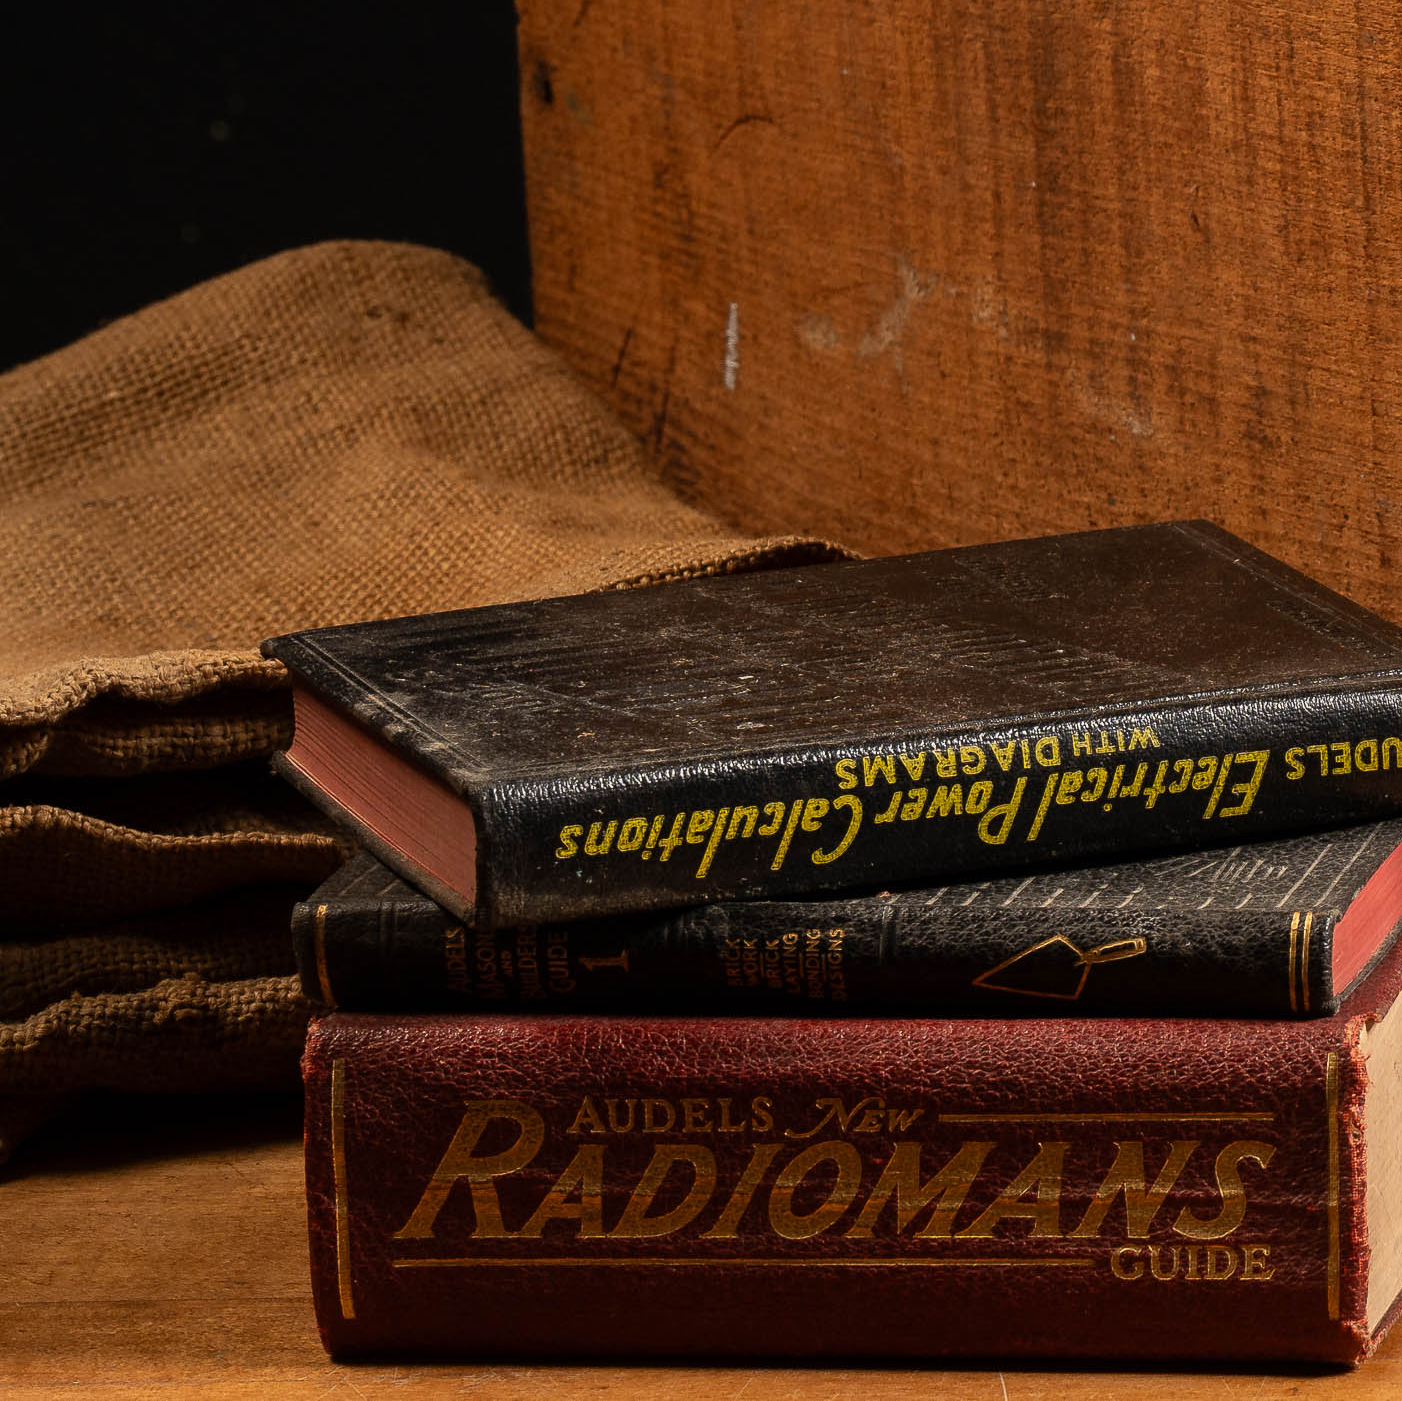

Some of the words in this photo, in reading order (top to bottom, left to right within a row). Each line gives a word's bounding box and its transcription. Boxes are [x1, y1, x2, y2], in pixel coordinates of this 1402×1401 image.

[835, 736, 1062, 790] DIAGRAMS
[1071, 725, 1161, 758] WITH
[874, 776, 1028, 846] Power
[1026, 749, 1271, 842] Electrical
[555, 793, 863, 879] Calculations
[546, 929, 577, 995] GUIDE
[782, 932, 799, 995] LAYING
[805, 927, 824, 999] BONDING
[826, 926, 848, 1002] DESIGNS
[566, 1096, 775, 1133] AUDELS
[393, 1099, 1278, 1240] RADIOMANS
[1110, 1244, 1276, 1281] GUIDE
